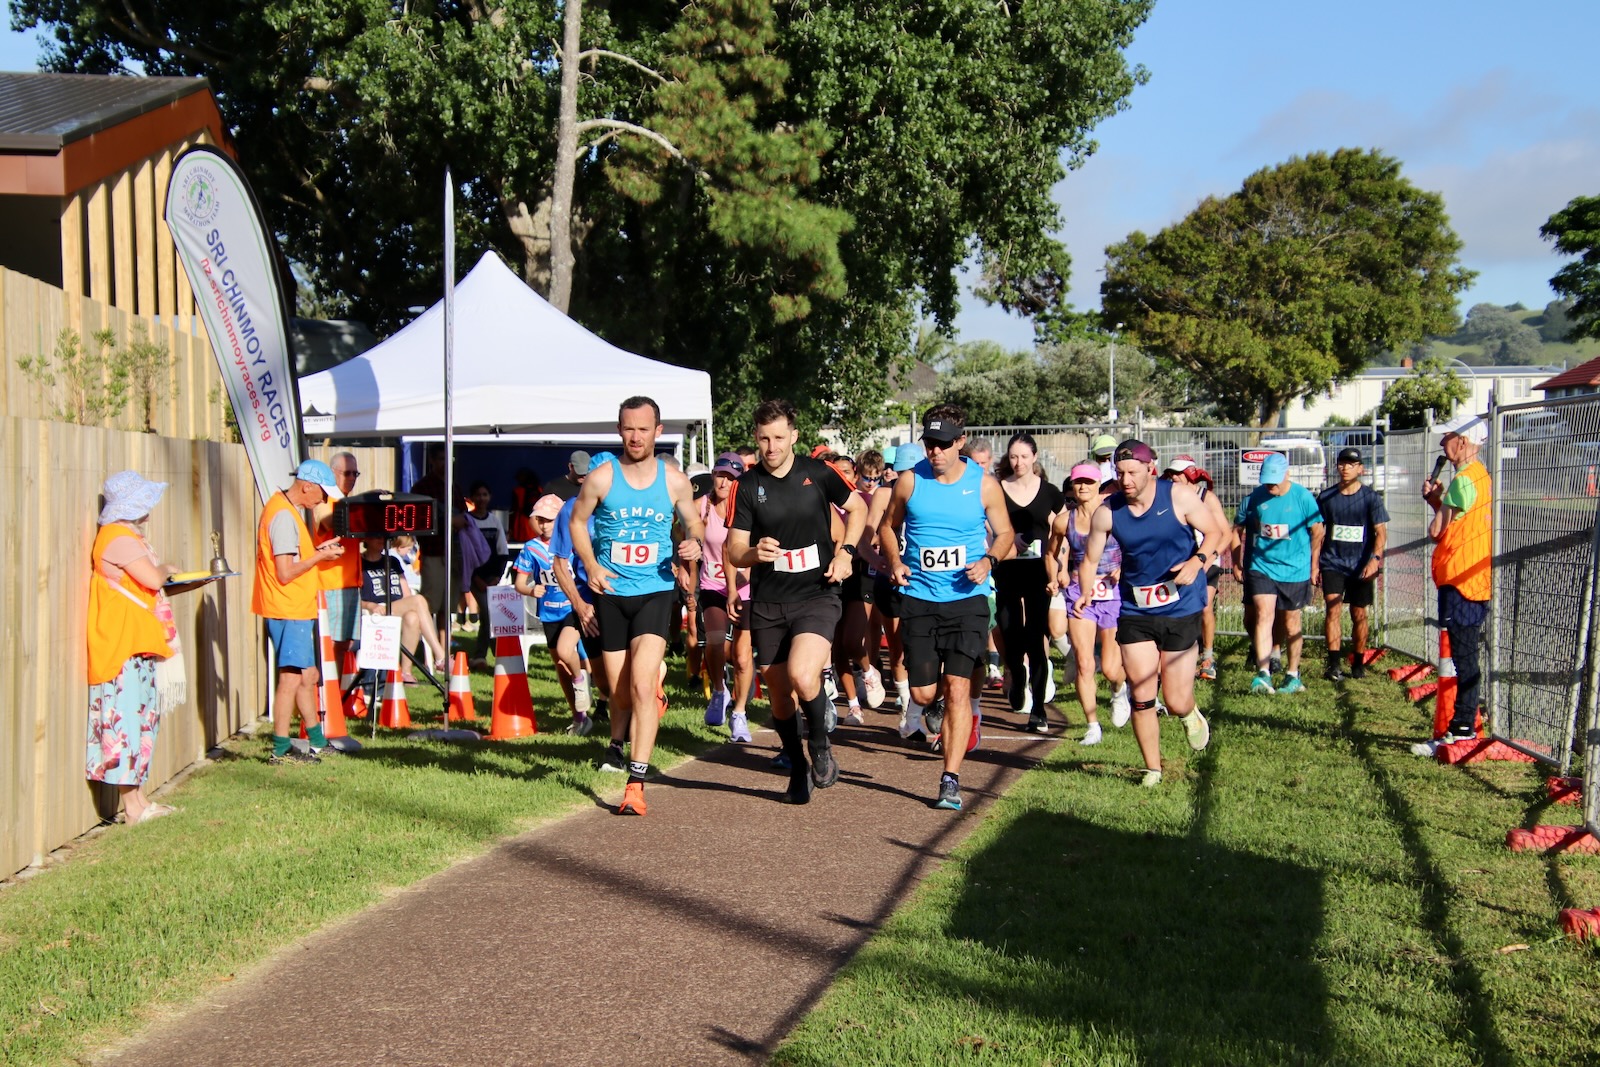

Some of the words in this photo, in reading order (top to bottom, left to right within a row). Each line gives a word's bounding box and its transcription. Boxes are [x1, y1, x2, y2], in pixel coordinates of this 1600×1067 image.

[190, 166, 215, 182] CHINMOY
[184, 206, 210, 227] MARATHON
[206, 228, 228, 267] SRI
[221, 269, 266, 366] CHINMOY
[258, 370, 291, 449] RACES
[200, 257, 272, 442] nz.srichinmoyraces.org
[384, 504, 431, 531] 0:01
[610, 506, 665, 522] TEMPO
[618, 529, 648, 540] FIT
[1264, 524, 1281, 538] 31
[1335, 527, 1361, 540] 233
[621, 544, 650, 564] 19
[783, 549, 806, 570] 11
[923, 548, 960, 568] 641
[713, 563, 726, 579] 2
[492, 592, 522, 601] FINISH
[1140, 584, 1170, 606] 70
[496, 602, 518, 623] FINISH
[375, 629, 383, 641] 5
[493, 624, 524, 635] FINISH
